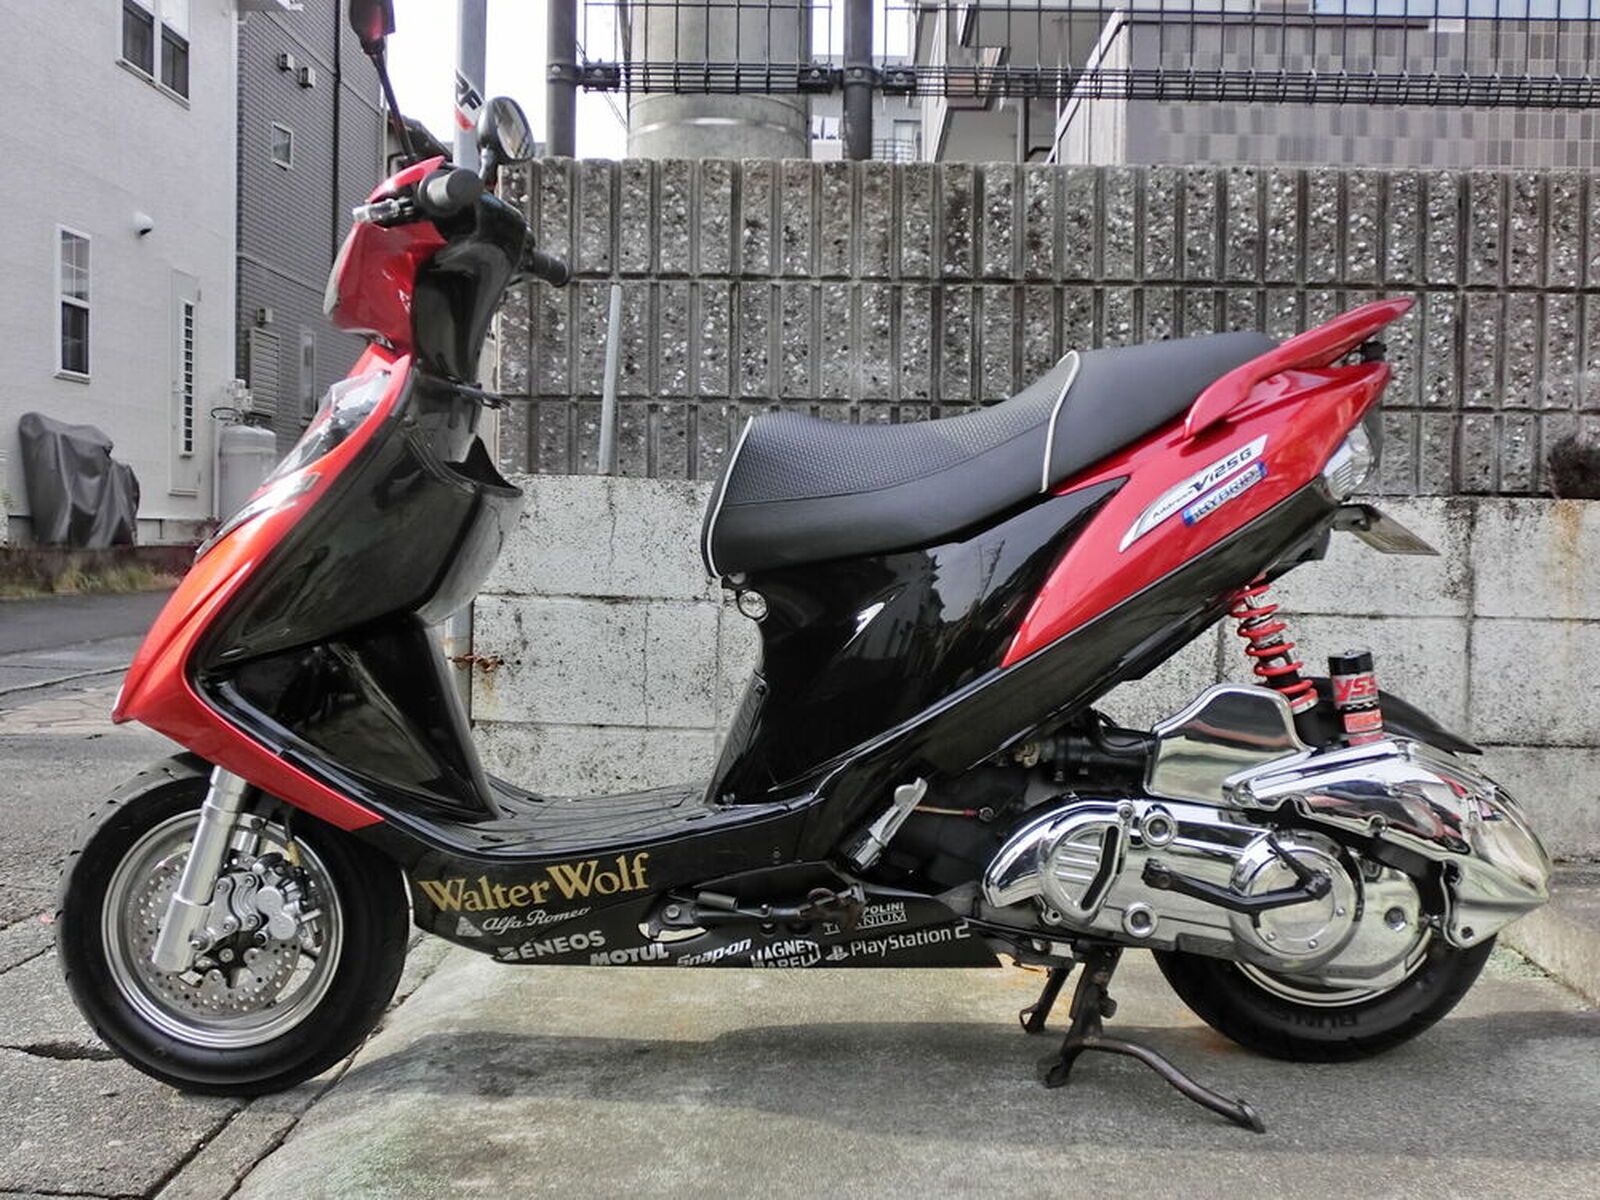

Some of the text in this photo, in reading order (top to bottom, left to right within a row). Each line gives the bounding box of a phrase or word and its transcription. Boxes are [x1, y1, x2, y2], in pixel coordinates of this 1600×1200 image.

[418, 852, 649, 912] Walter Wolf
[482, 906, 591, 935] Alfa Romeo
[862, 902, 905, 916] POLINI
[850, 921, 971, 957] PlayStation 2
[590, 943, 670, 966] MOTUL
